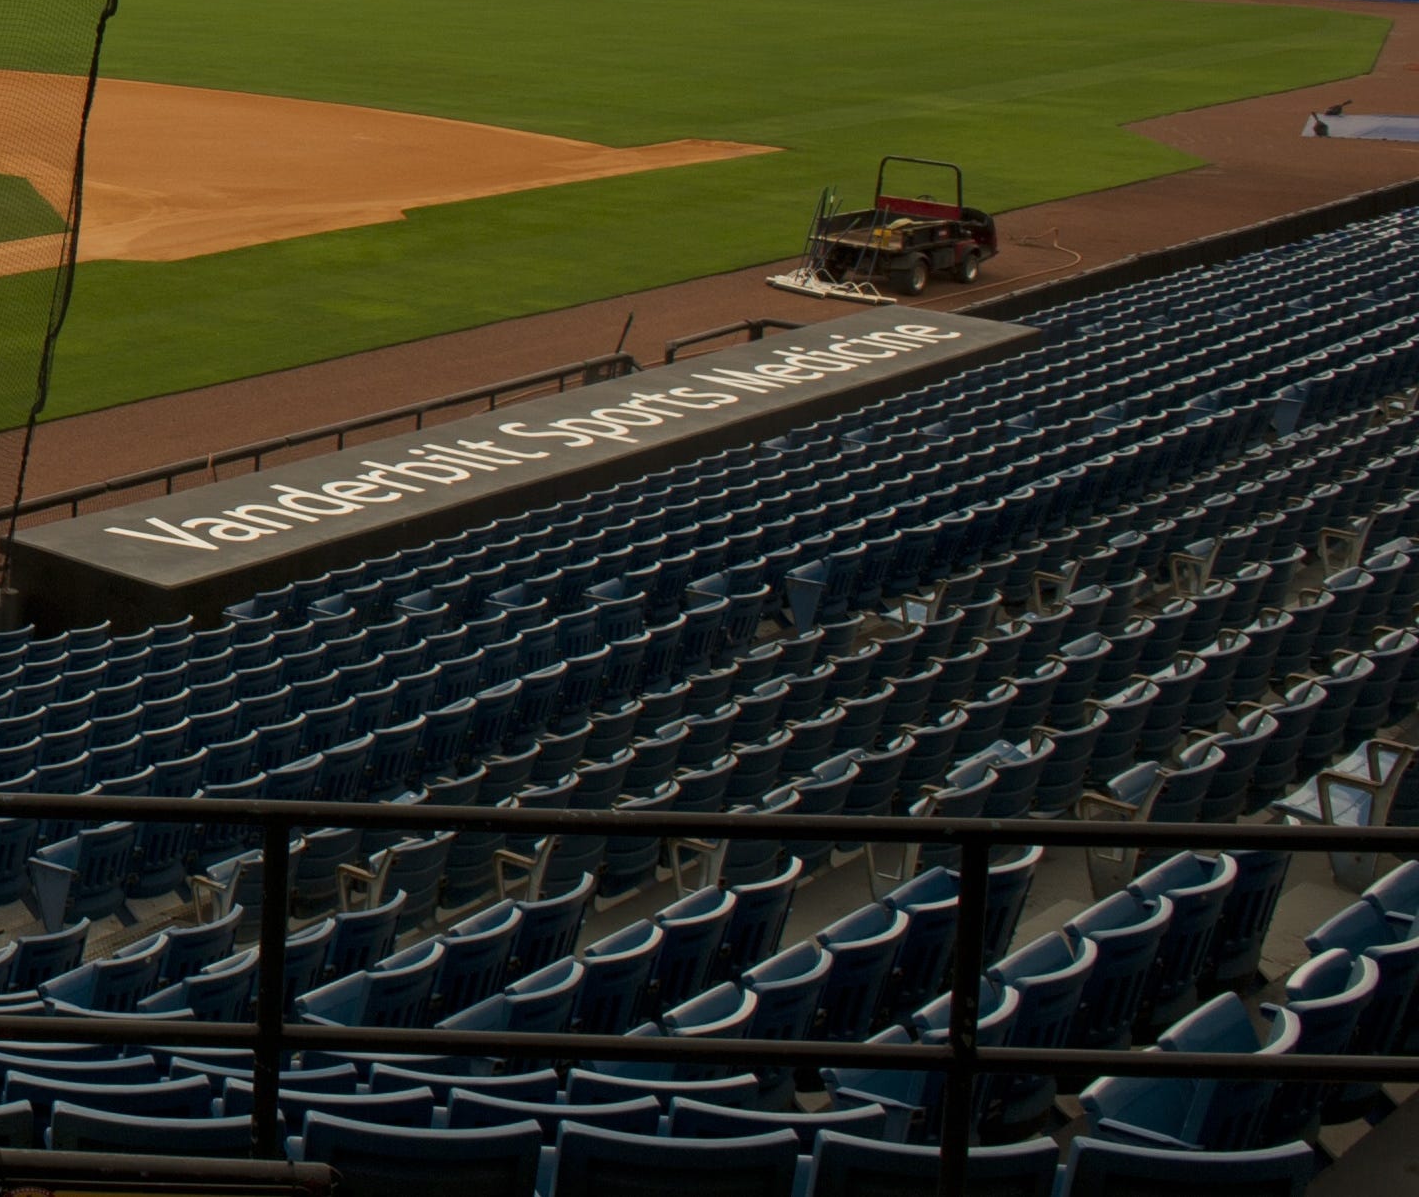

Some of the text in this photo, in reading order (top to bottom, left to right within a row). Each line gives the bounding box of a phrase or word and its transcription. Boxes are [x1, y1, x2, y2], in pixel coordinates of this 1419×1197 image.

[103, 323, 962, 551] Vanderbilt Sports Medicine
